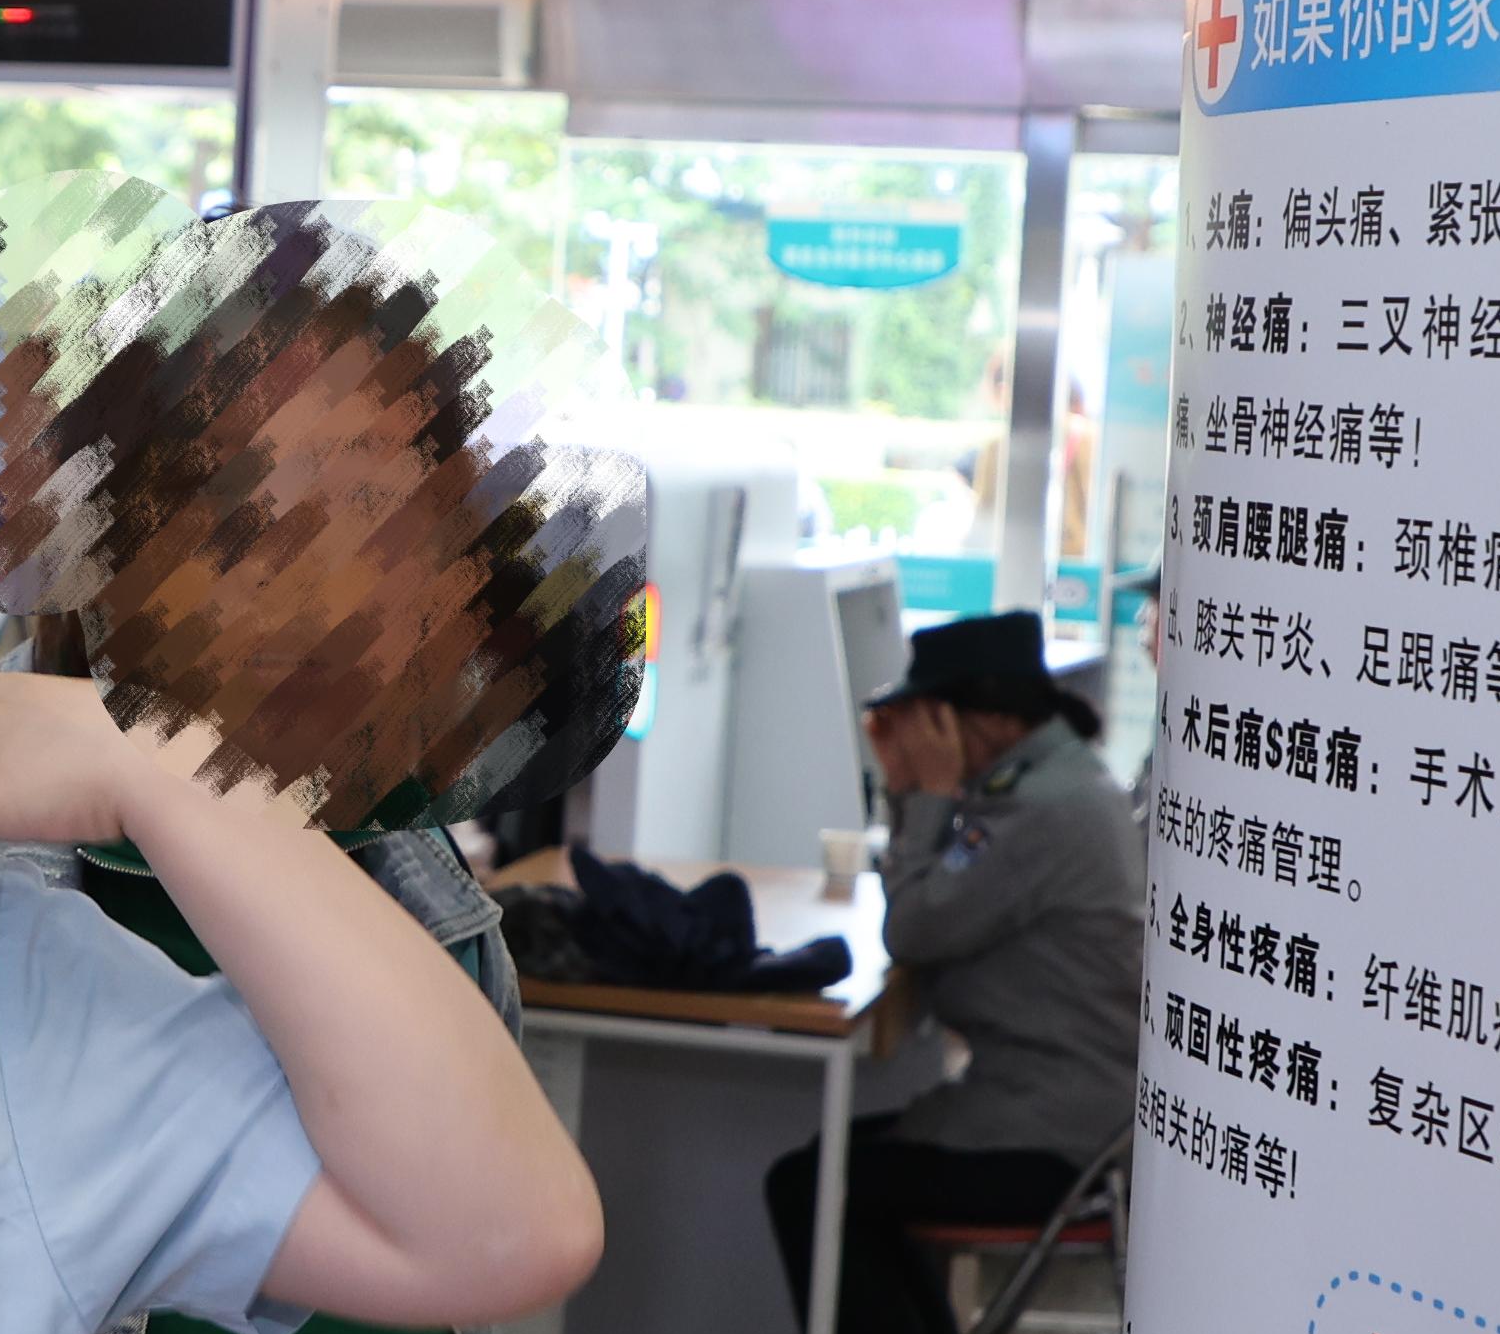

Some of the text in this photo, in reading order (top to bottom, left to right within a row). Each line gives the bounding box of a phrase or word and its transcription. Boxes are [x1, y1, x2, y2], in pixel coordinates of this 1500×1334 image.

[1156, 780, 1362, 904] 相关的疼痛管理。
